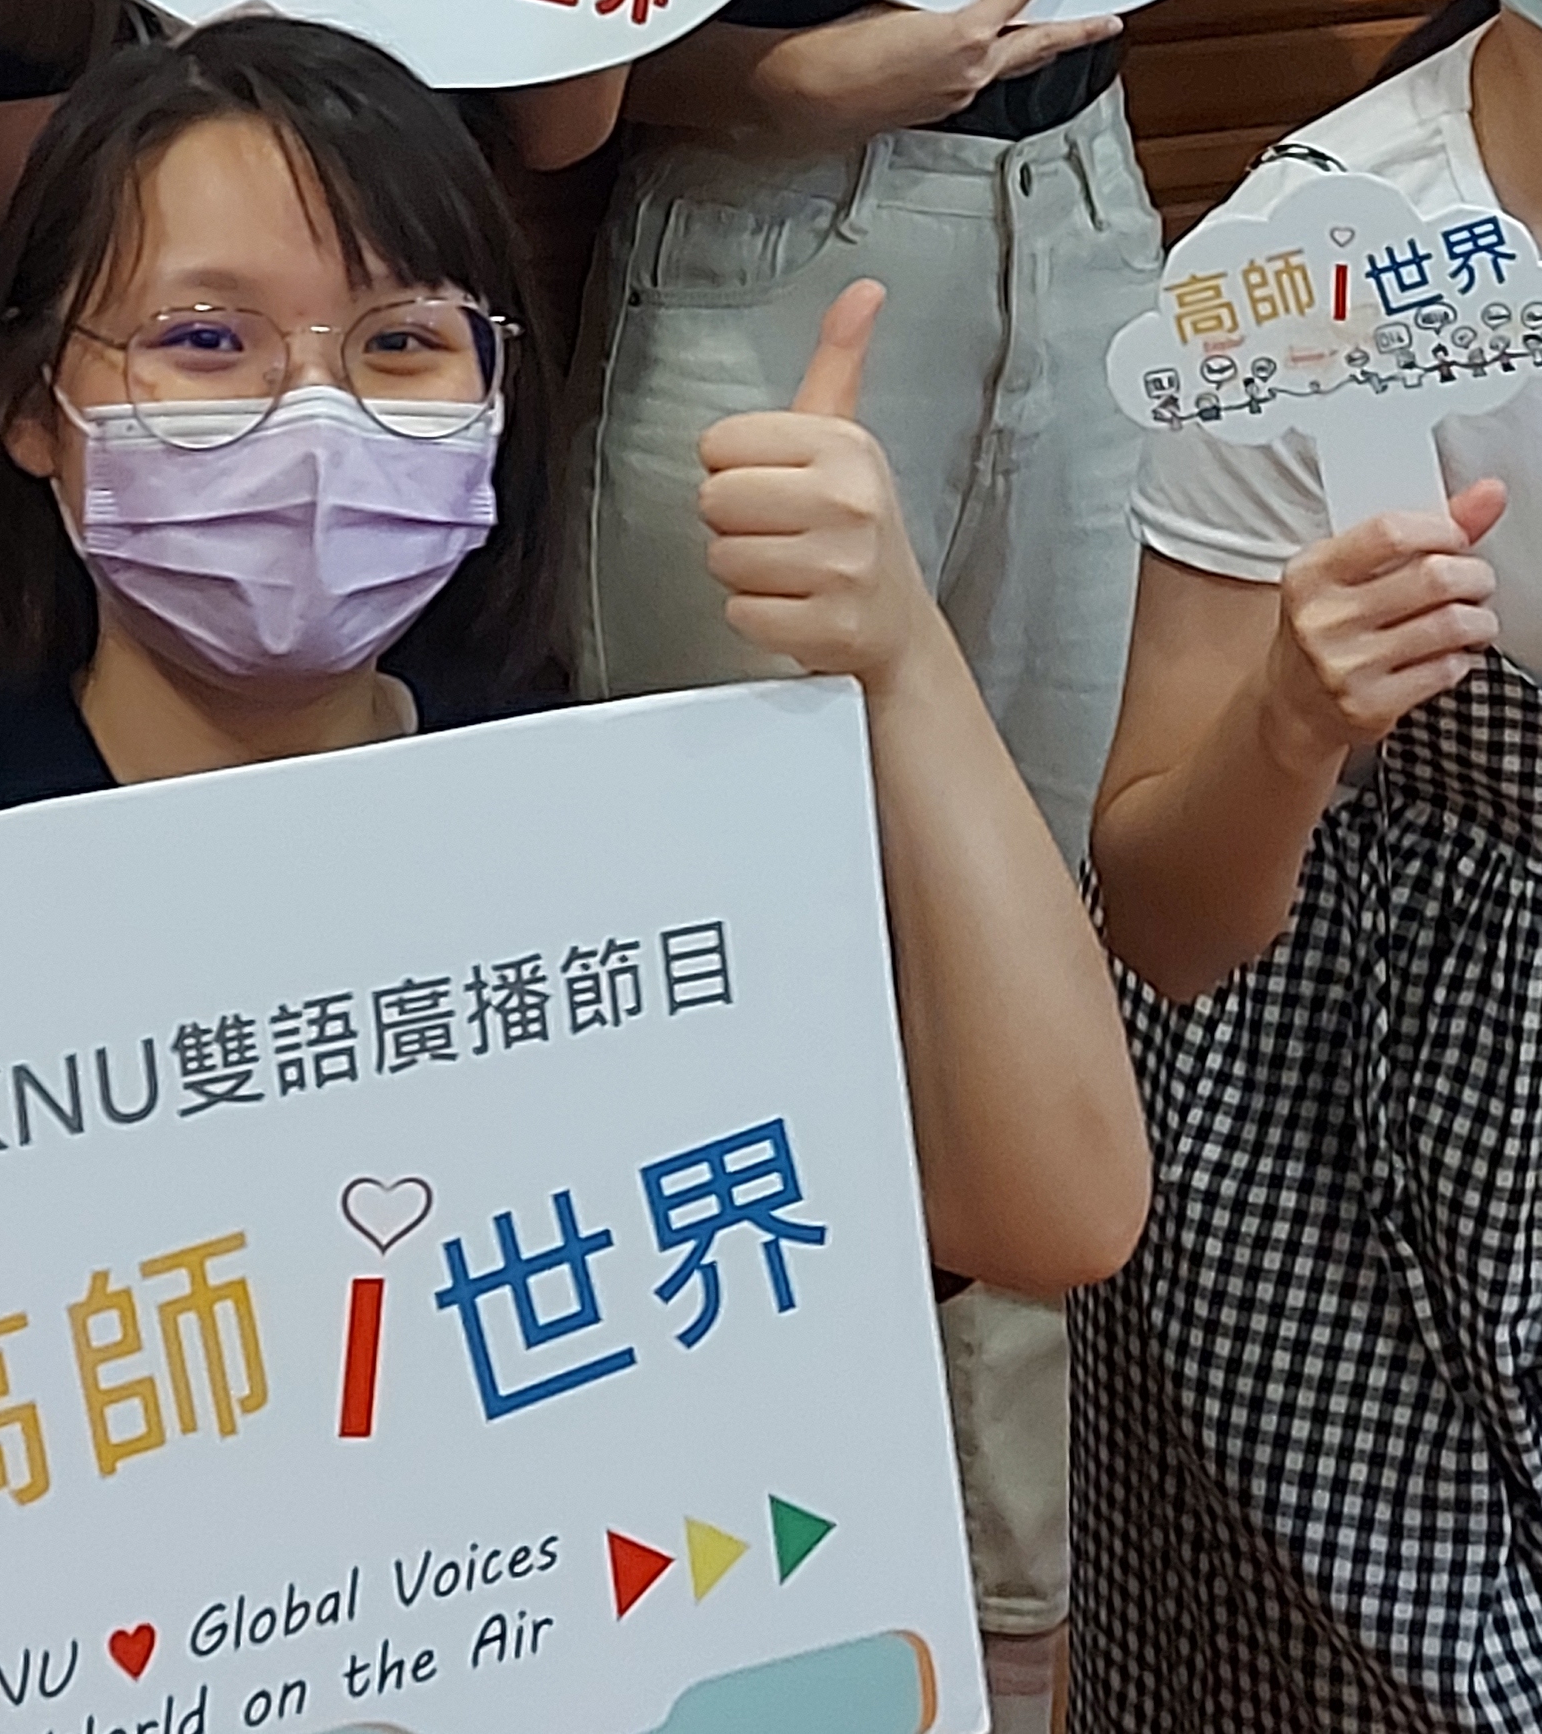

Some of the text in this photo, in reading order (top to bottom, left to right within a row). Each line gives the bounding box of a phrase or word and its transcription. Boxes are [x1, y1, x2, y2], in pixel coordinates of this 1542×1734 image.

[189, 1566, 359, 1657] Global
[394, 1534, 559, 1607] Voices
[242, 1679, 307, 1727] on
[344, 1640, 438, 1698] the
[470, 1612, 554, 1669] Air
